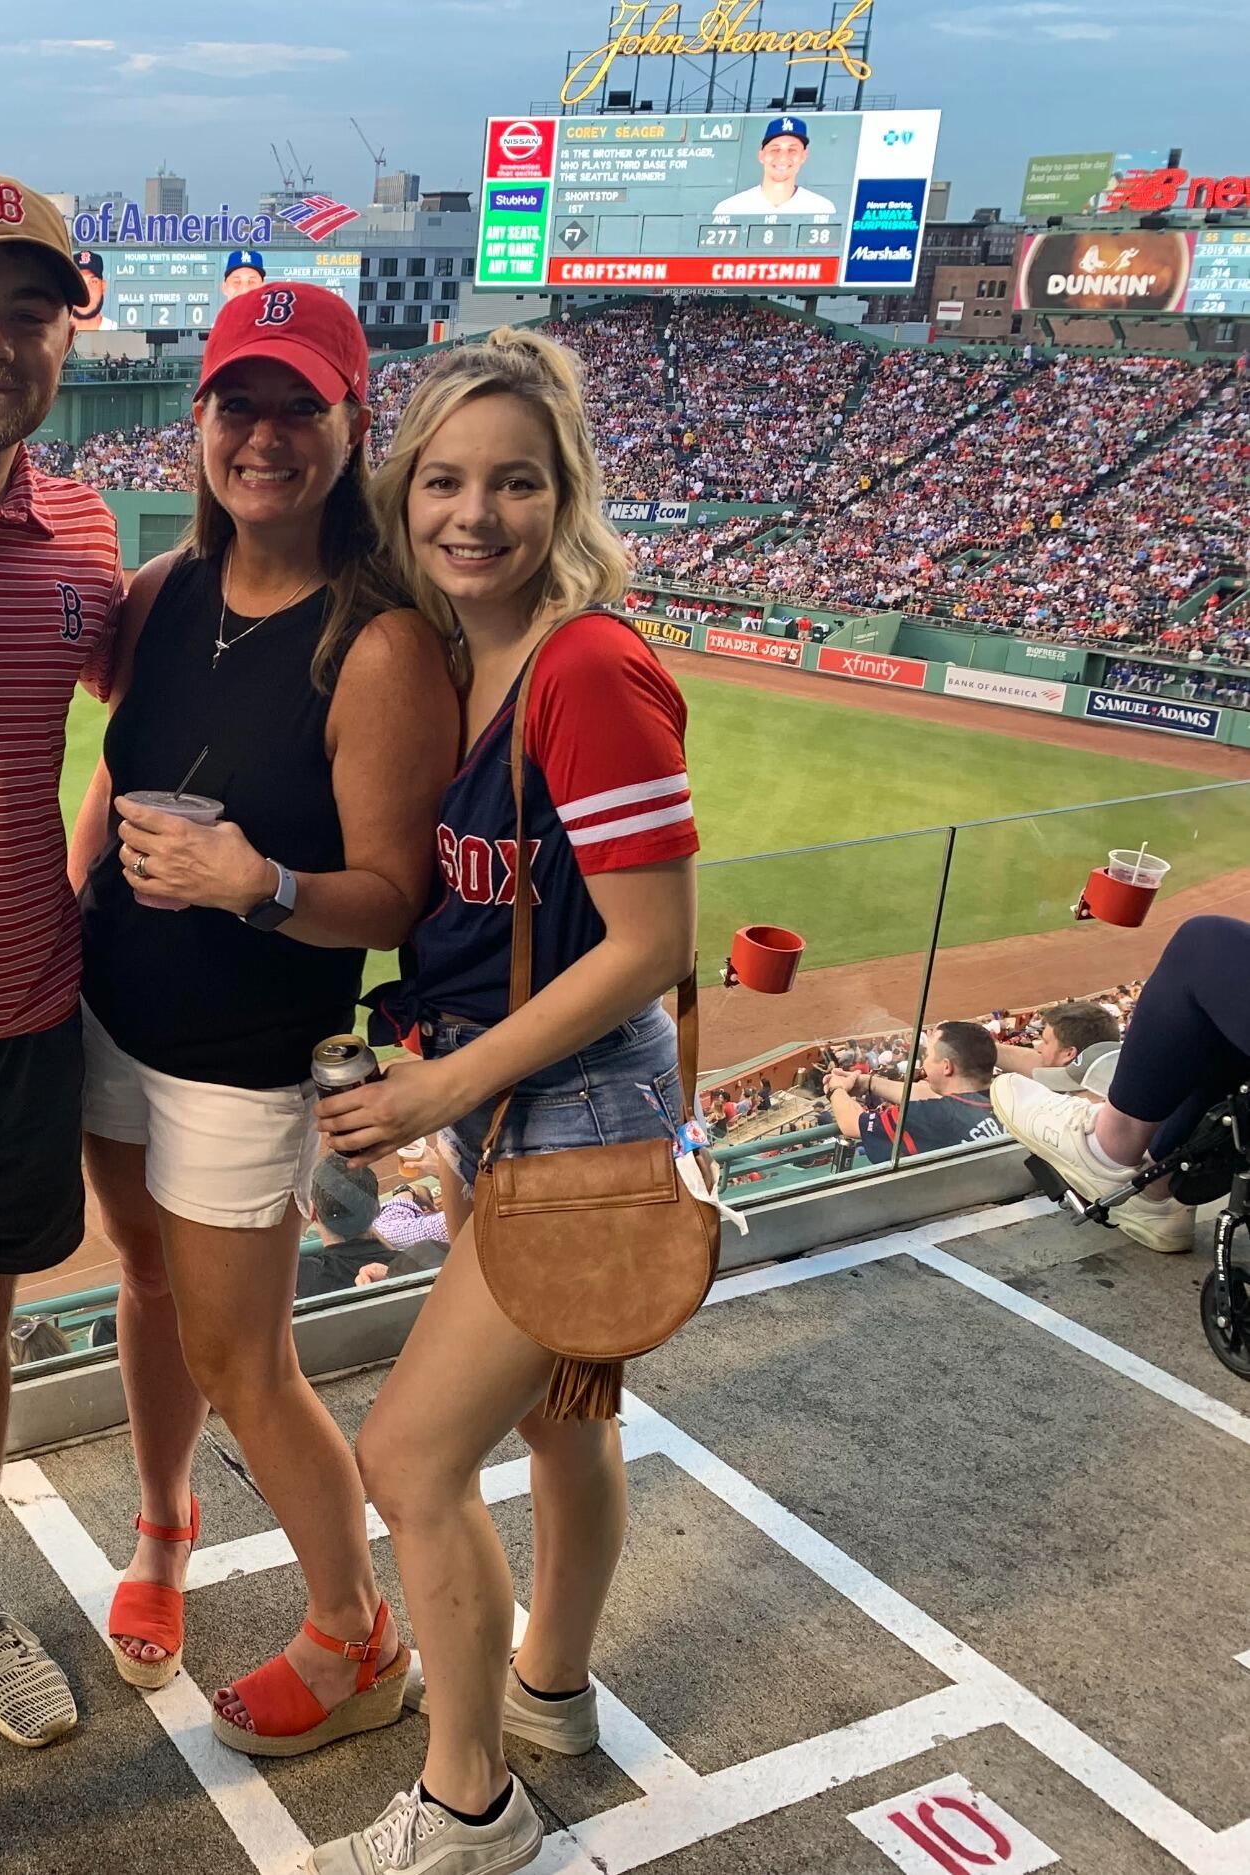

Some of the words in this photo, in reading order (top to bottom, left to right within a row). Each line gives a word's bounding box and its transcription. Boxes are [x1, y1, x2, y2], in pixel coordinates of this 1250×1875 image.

[567, 126, 607, 139] COREY
[615, 125, 665, 138] SEAGER
[700, 124, 733, 139] LAD
[561, 149, 569, 158] IS
[573, 149, 590, 158] THE
[593, 149, 632, 158] BROTHER
[636, 149, 647, 158] OF
[651, 148, 674, 158] KYLE
[560, 161, 579, 170] WHO
[582, 161, 611, 170] PLAYS
[615, 161, 641, 170] THIRD
[643, 161, 666, 169] BASE
[669, 160, 688, 169] FOR
[1054, 163, 1062, 171] to
[560, 173, 577, 182] THE
[580, 172, 619, 181] SEATTLE
[622, 172, 666, 181] MARINERS
[564, 192, 619, 201] SHORTSTOP
[1186, 176, 1250, 209] ne
[495, 195, 537, 206] StubHub
[73, 201, 114, 243] of
[118, 201, 272, 244] America
[862, 210, 913, 220] ALWAYS
[564, 229, 581, 241] F7
[700, 229, 737, 244] .277
[763, 230, 774, 244] 8
[809, 229, 830, 244] 38
[316, 255, 361, 265] SEAGER
[850, 246, 912, 260] Marshalls
[116, 265, 134, 275] LAD
[171, 265, 188, 274] BOS
[562, 264, 667, 279] CRAFTSMAN
[712, 264, 821, 280] CRAFTSMAN
[118, 294, 144, 302] BALLS
[148, 294, 181, 302] STRIKES
[188, 294, 208, 302] OUTS
[255, 290, 296, 327] B
[126, 308, 137, 325] 0
[158, 308, 169, 325] 2
[193, 308, 203, 325] 0
[55, 581, 84, 642] B
[632, 619, 660, 634] NITE
[663, 623, 690, 644] CITY
[709, 635, 758, 653] TRADER
[762, 642, 799, 660] JOE'S
[842, 654, 900, 680] xfinity
[948, 678, 974, 688] BANK
[977, 682, 989, 690] OF
[992, 685, 1037, 698] AMERICA
[1093, 695, 1150, 715] SAMUEL
[1156, 705, 1211, 728] ADAMS
[437, 823, 542, 905] SOX
[887, 1797, 1011, 1875] 10
